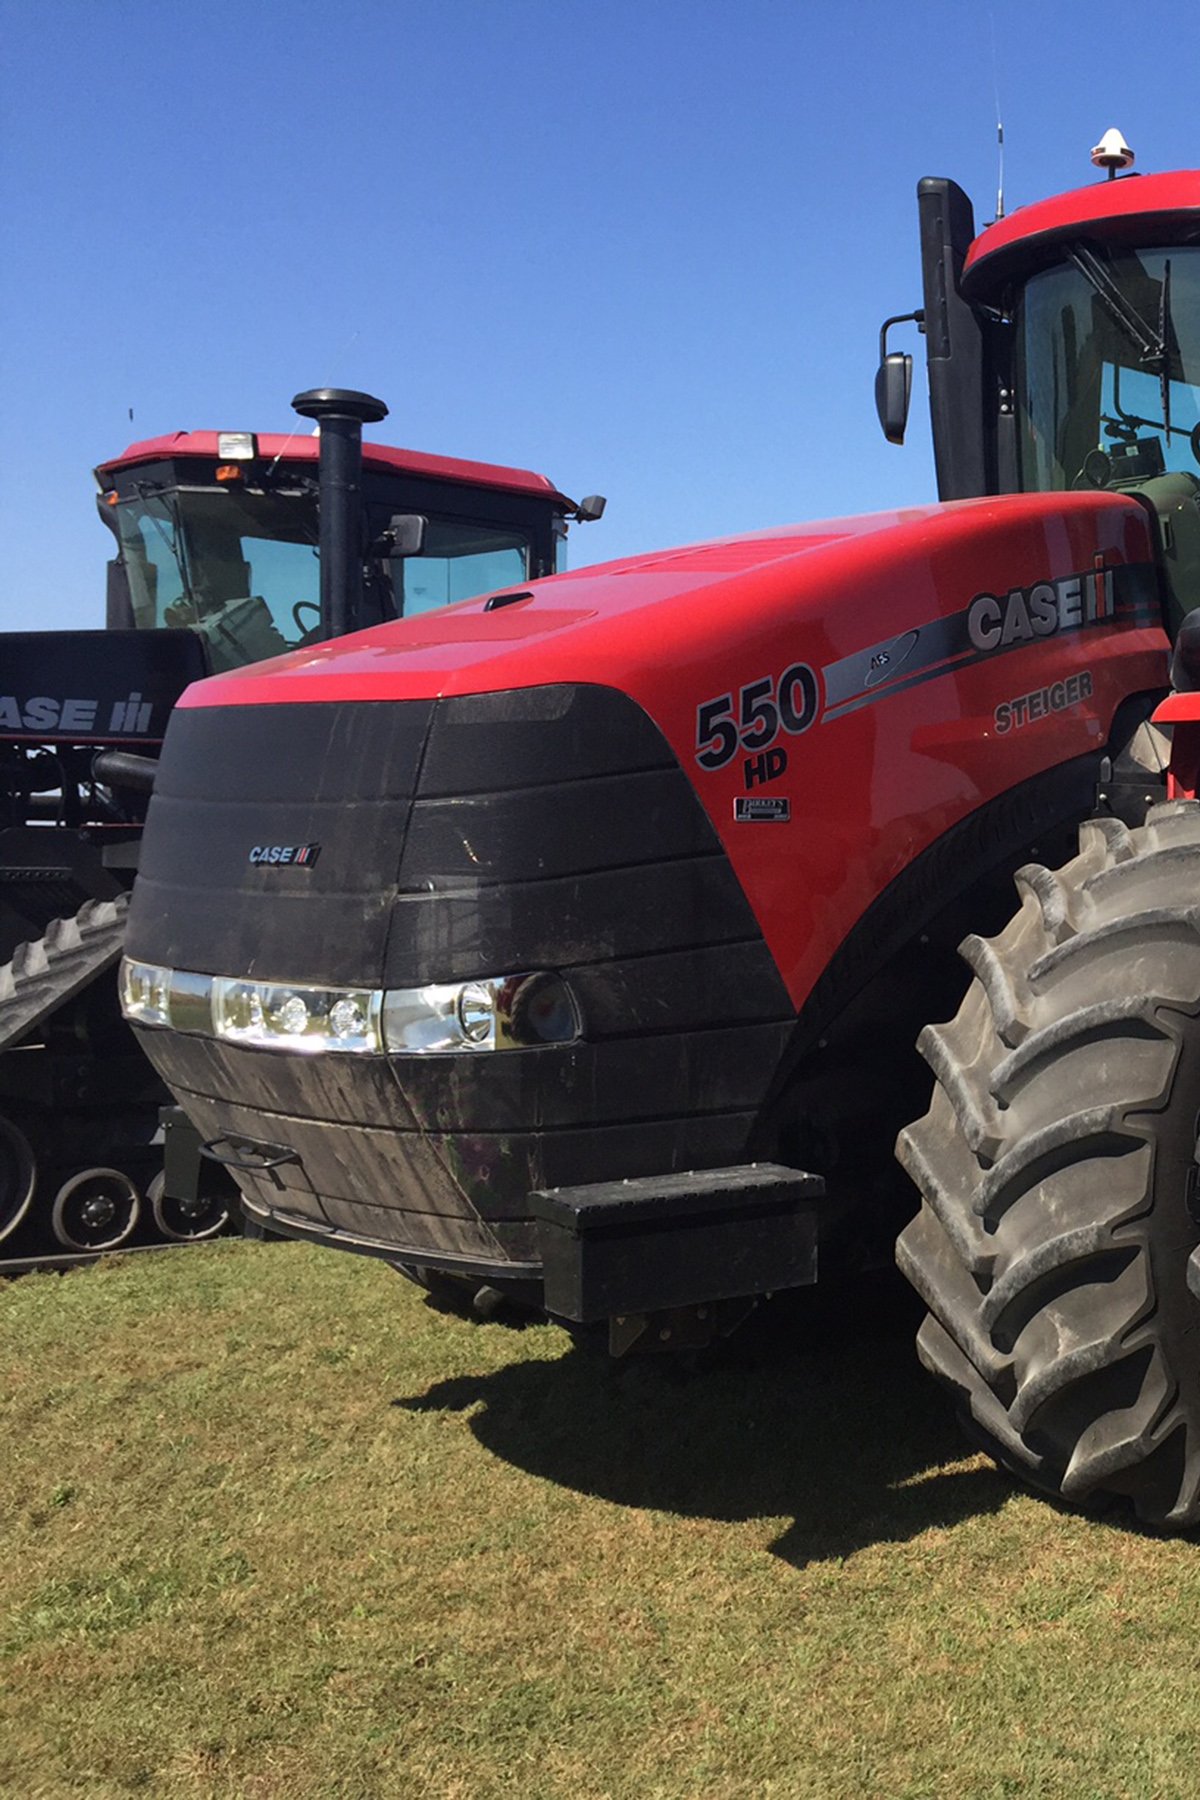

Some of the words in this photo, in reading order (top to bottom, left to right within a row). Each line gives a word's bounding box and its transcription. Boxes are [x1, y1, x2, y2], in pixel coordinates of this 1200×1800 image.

[968, 578, 1083, 651] CASE
[0, 696, 98, 730] ASE
[695, 663, 817, 771] 550
[993, 671, 1093, 735] STEIGER
[743, 747, 787, 789] HD
[249, 846, 294, 863] CASE
